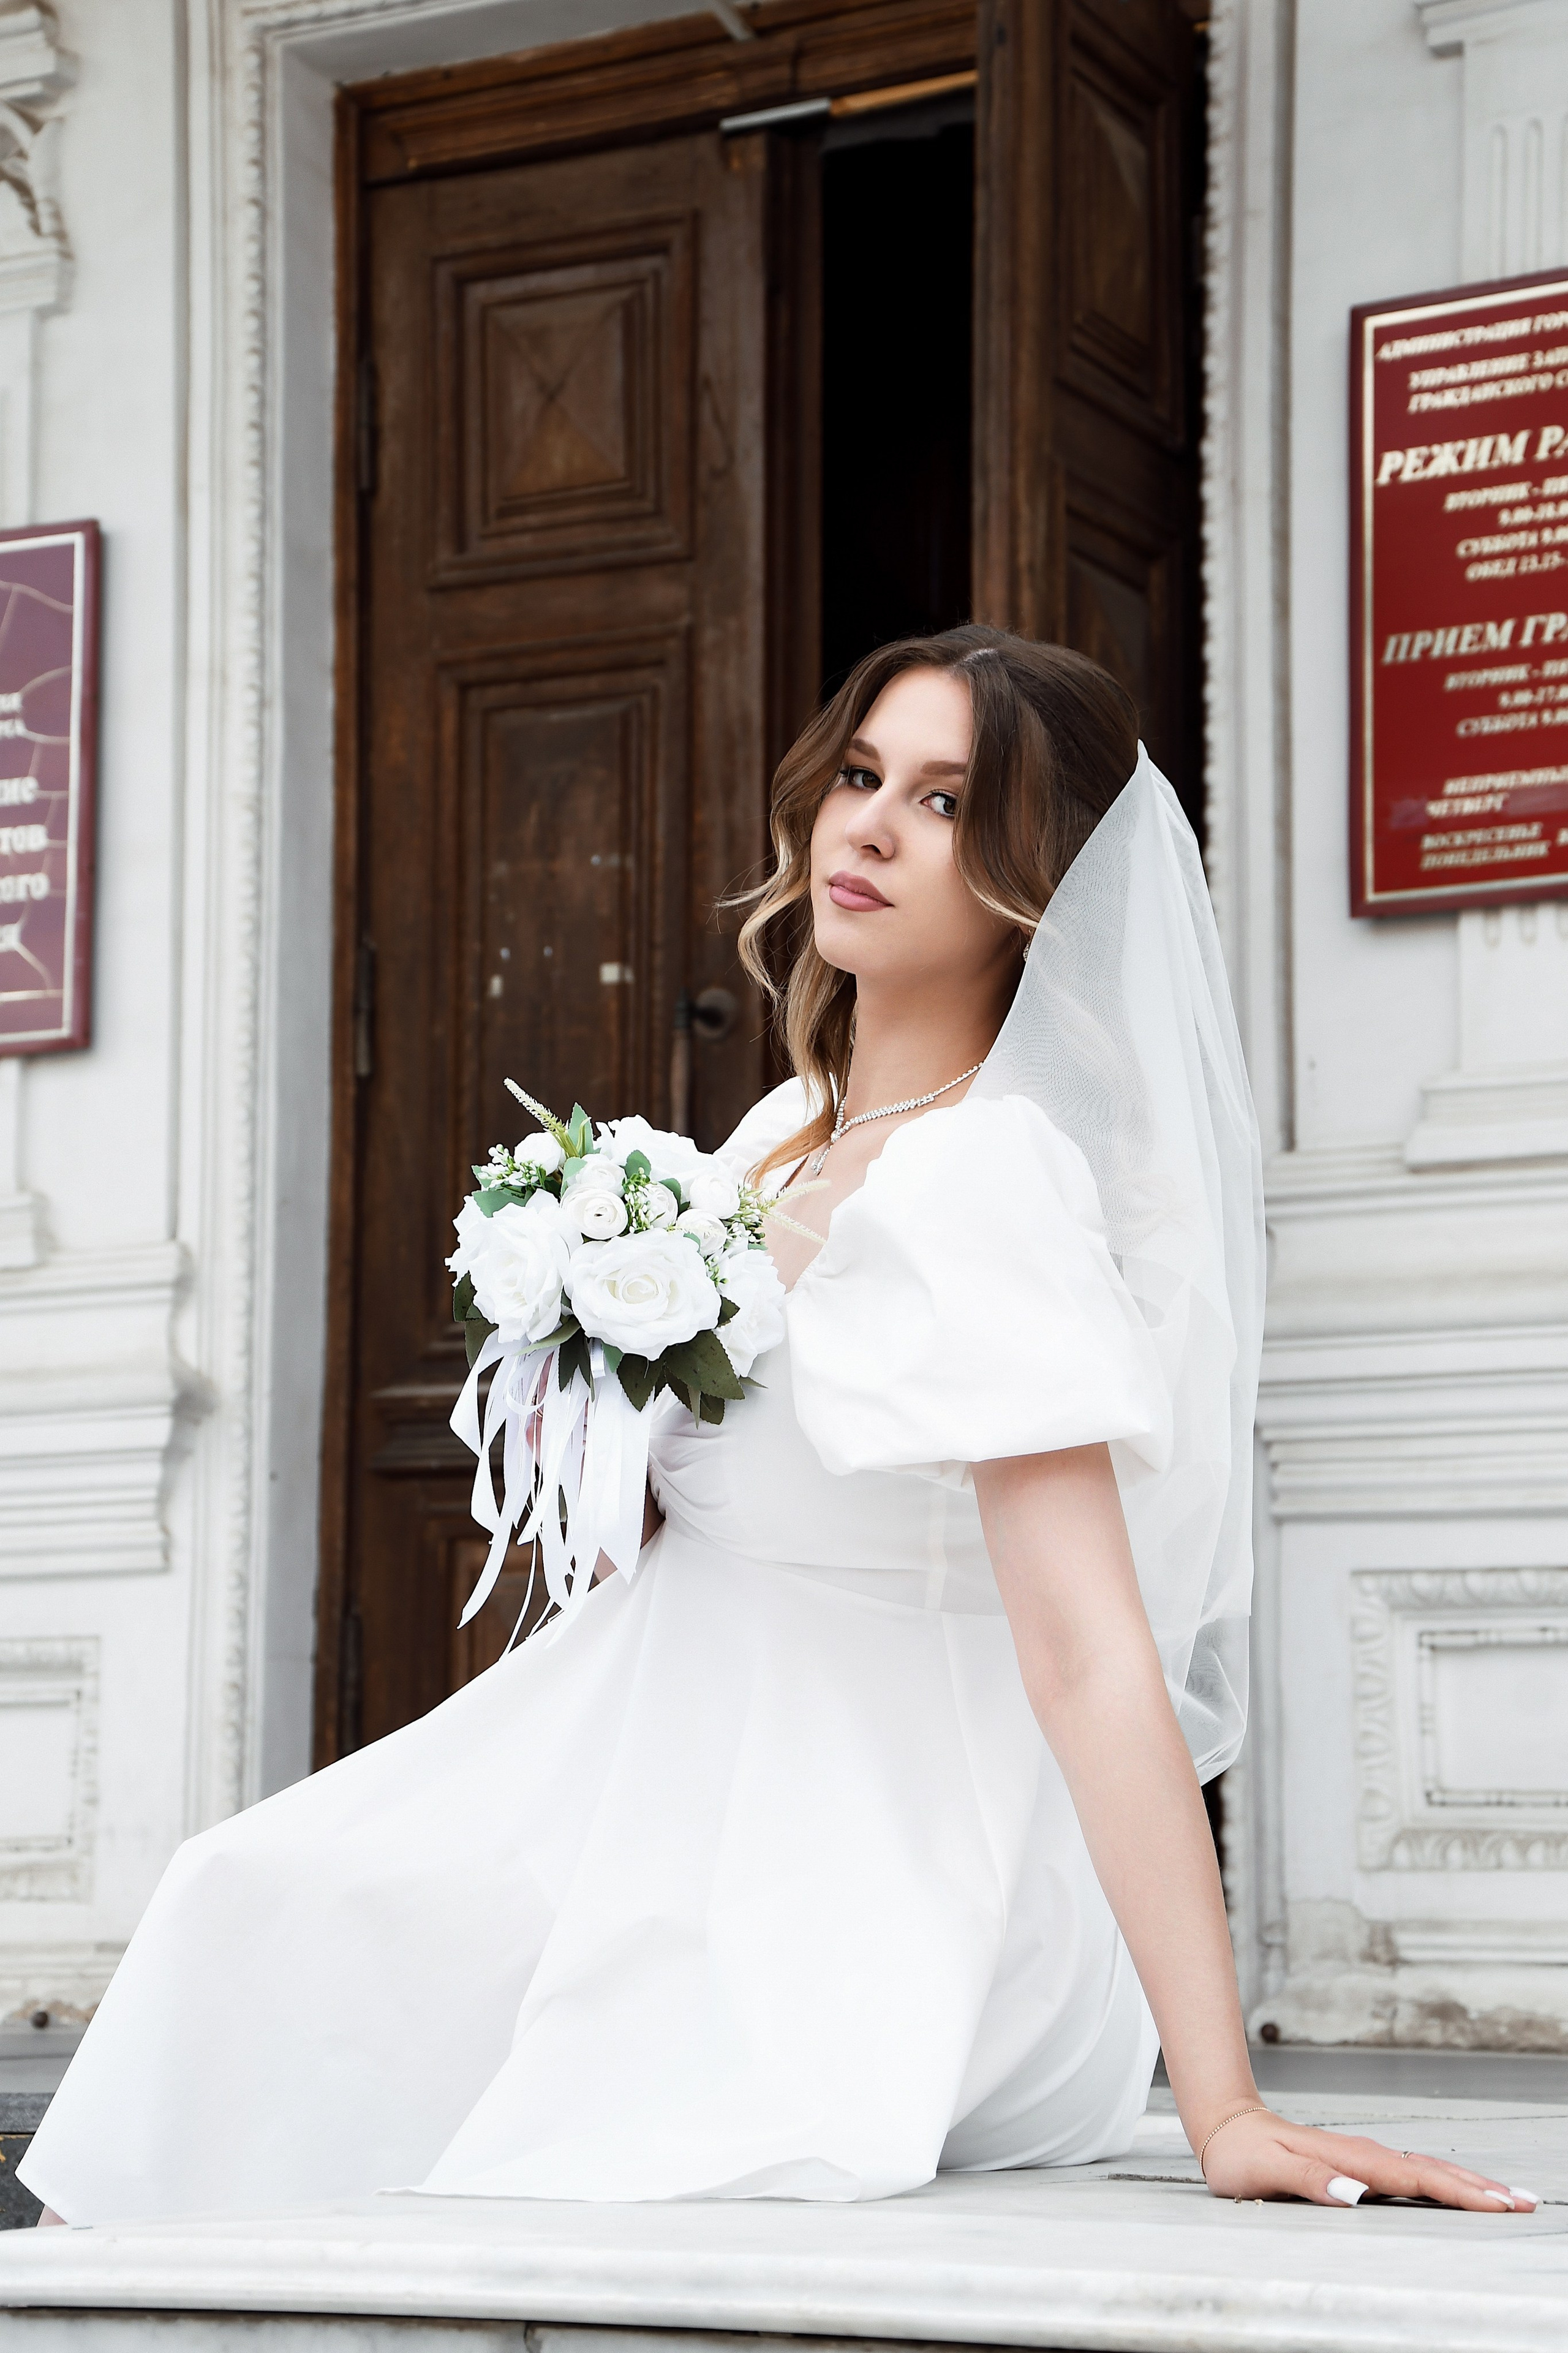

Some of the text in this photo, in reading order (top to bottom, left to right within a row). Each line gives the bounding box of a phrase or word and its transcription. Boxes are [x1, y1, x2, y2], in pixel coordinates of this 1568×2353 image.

[1375, 429, 1532, 486] РЕЖИМ
[1382, 611, 1568, 665] ПРИЕМ ГР
